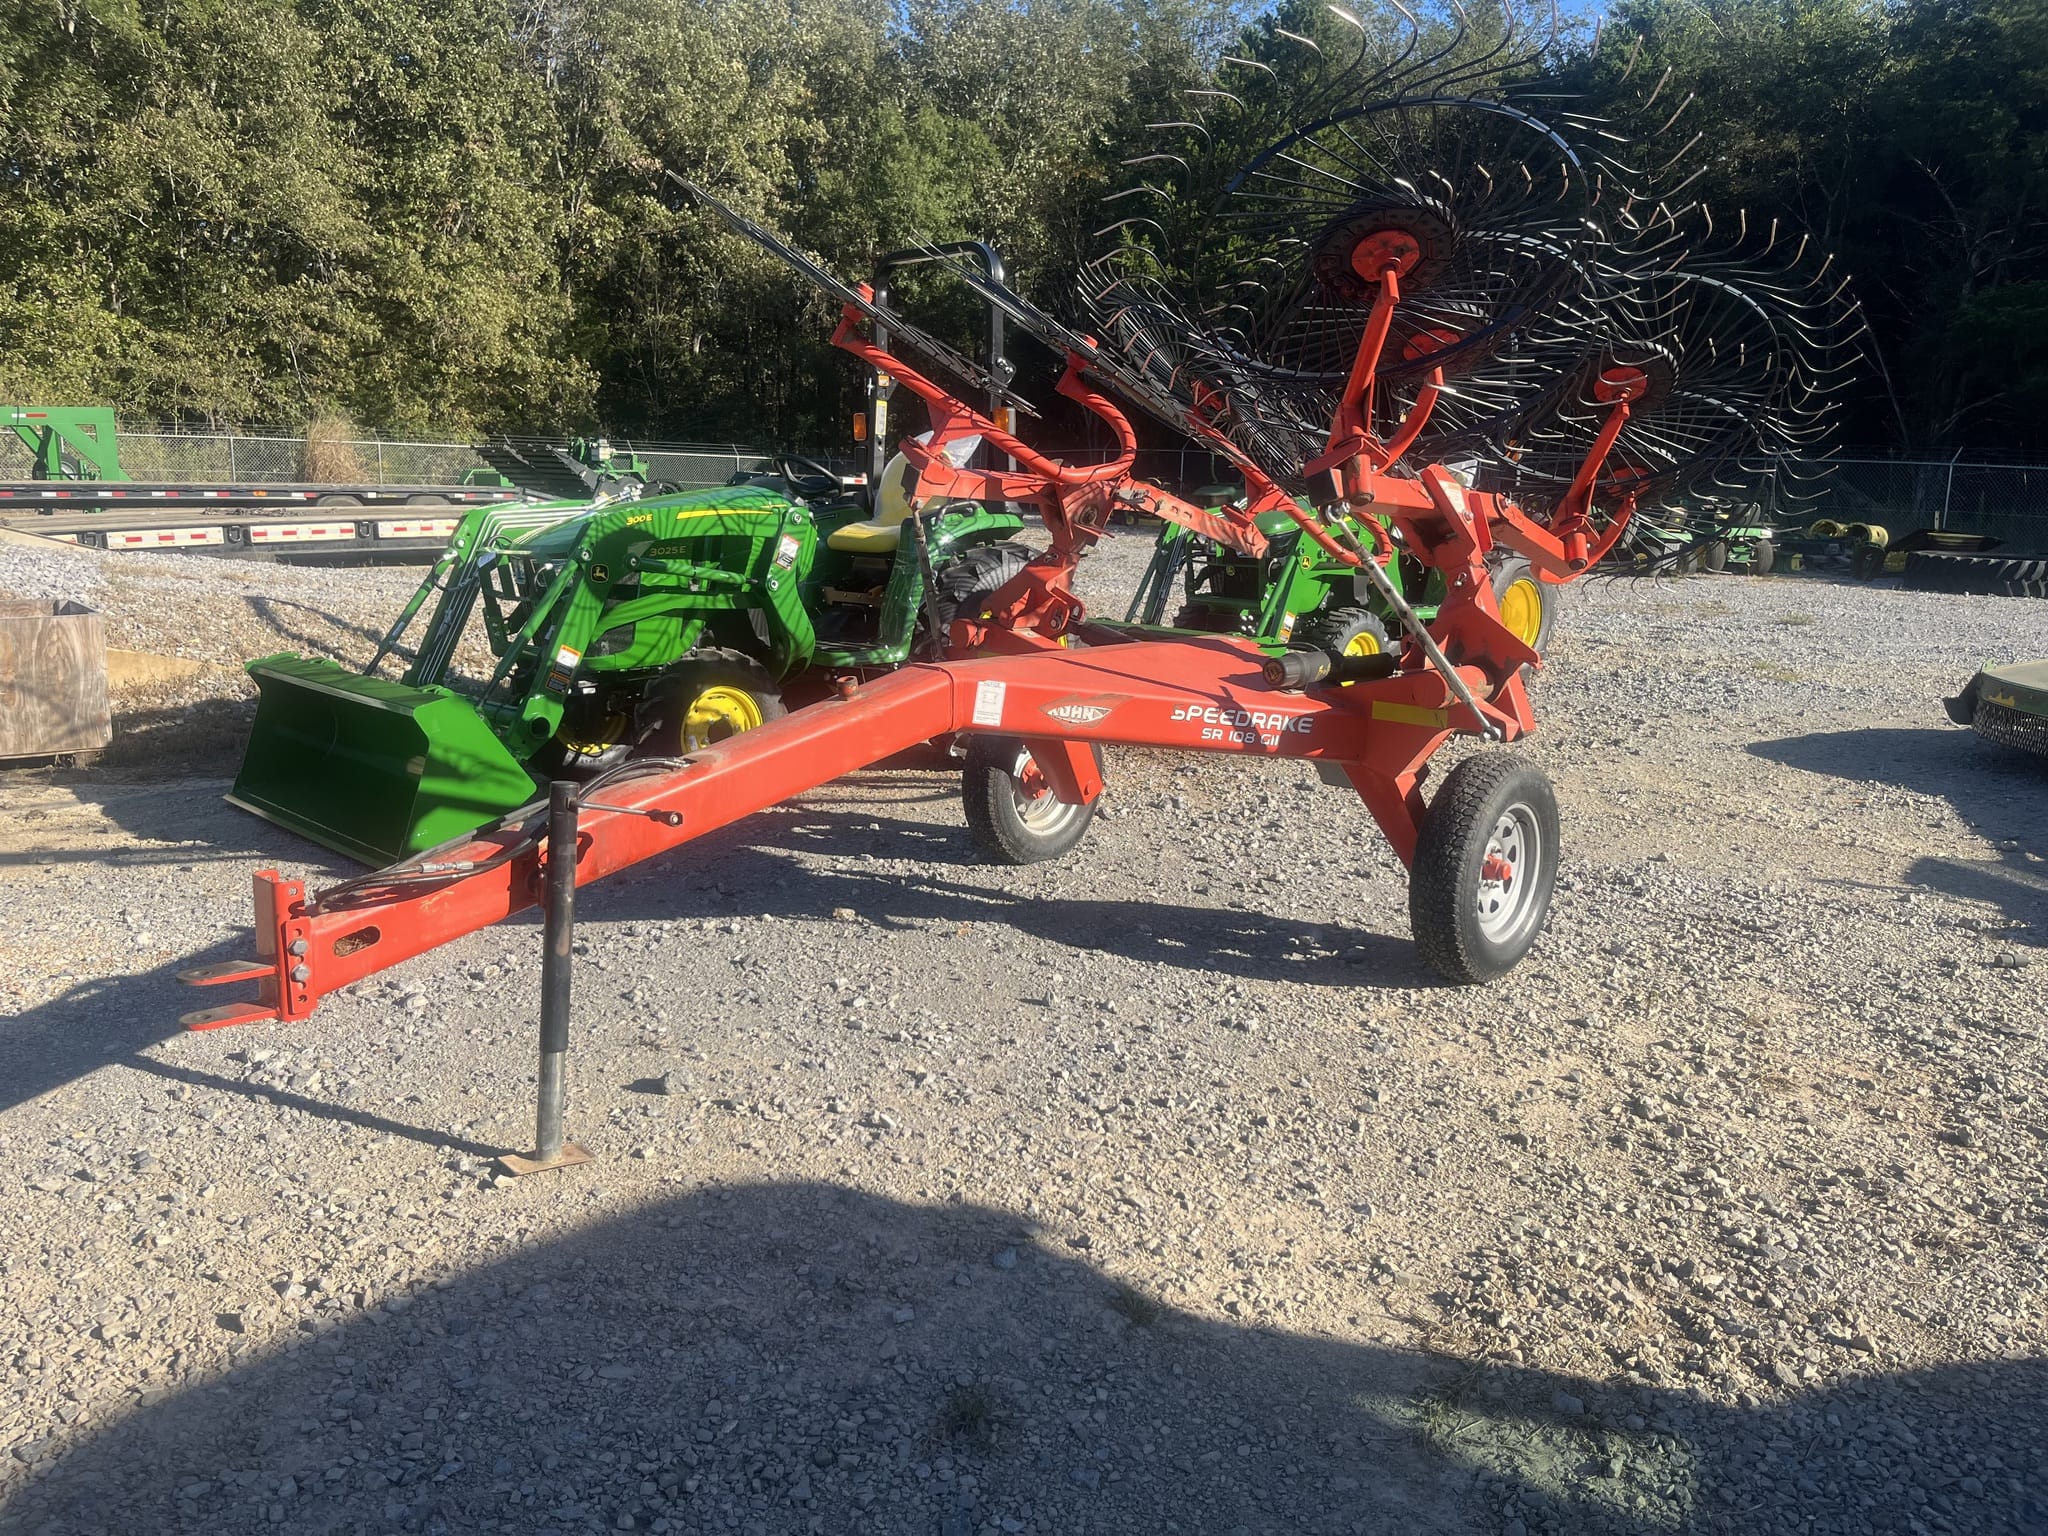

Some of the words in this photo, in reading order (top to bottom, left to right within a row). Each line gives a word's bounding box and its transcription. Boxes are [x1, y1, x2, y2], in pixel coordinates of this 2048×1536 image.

[649, 545, 687, 557] 3025E
[1170, 705, 1314, 733] SPEEDRAKE
[1201, 728, 1223, 741] SR
